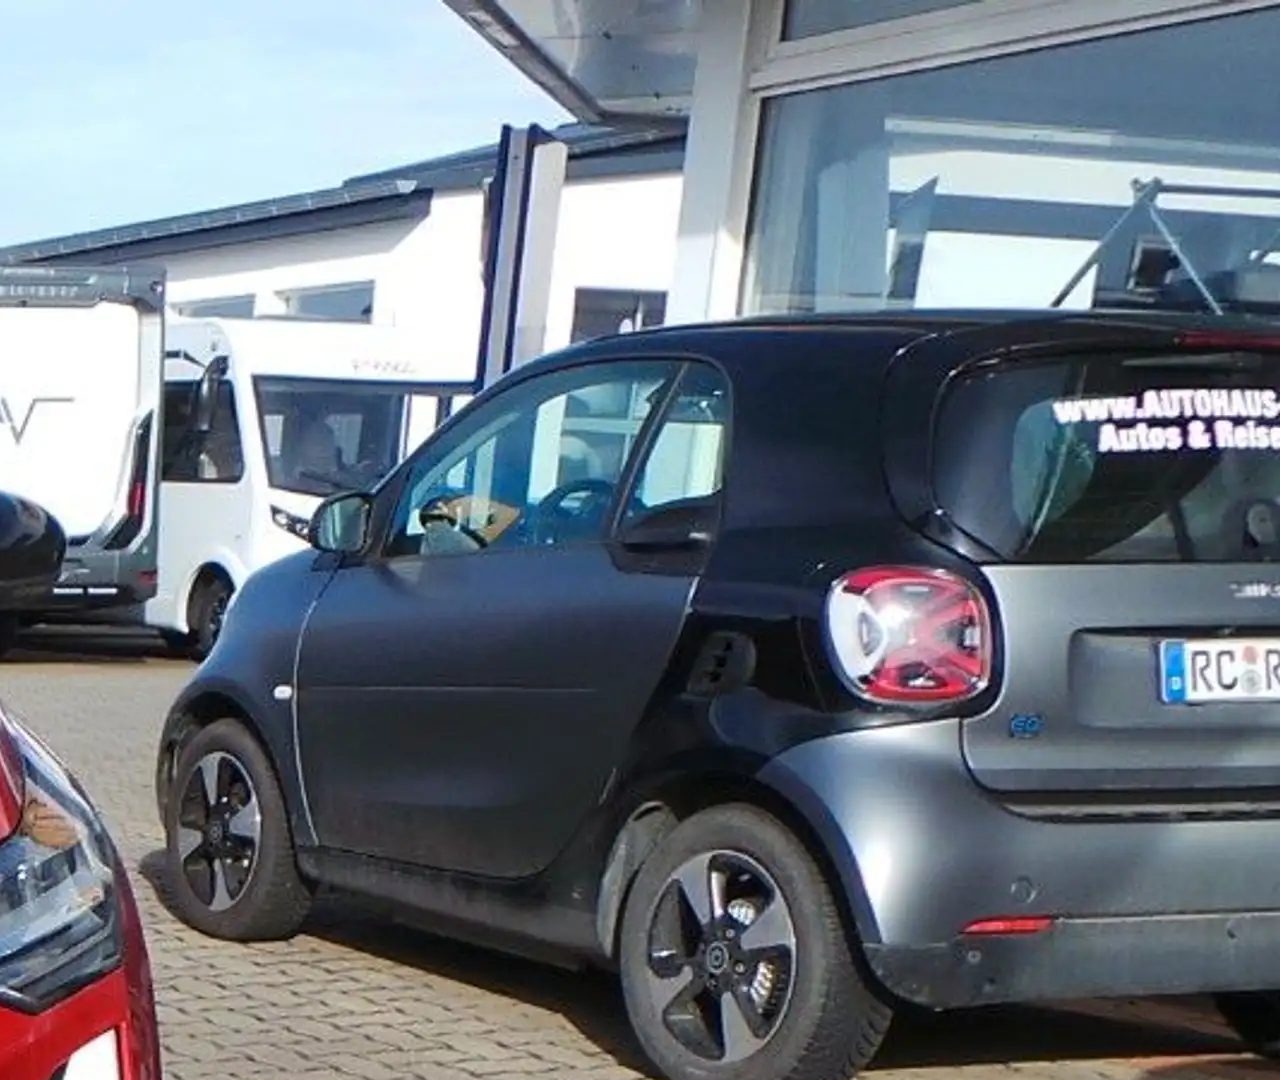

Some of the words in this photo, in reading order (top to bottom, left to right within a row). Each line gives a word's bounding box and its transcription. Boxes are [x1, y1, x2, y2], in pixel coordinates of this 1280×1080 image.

[1098, 422, 1183, 452] Autos
[1187, 420, 1212, 449] &
[1191, 649, 1239, 692] RC
